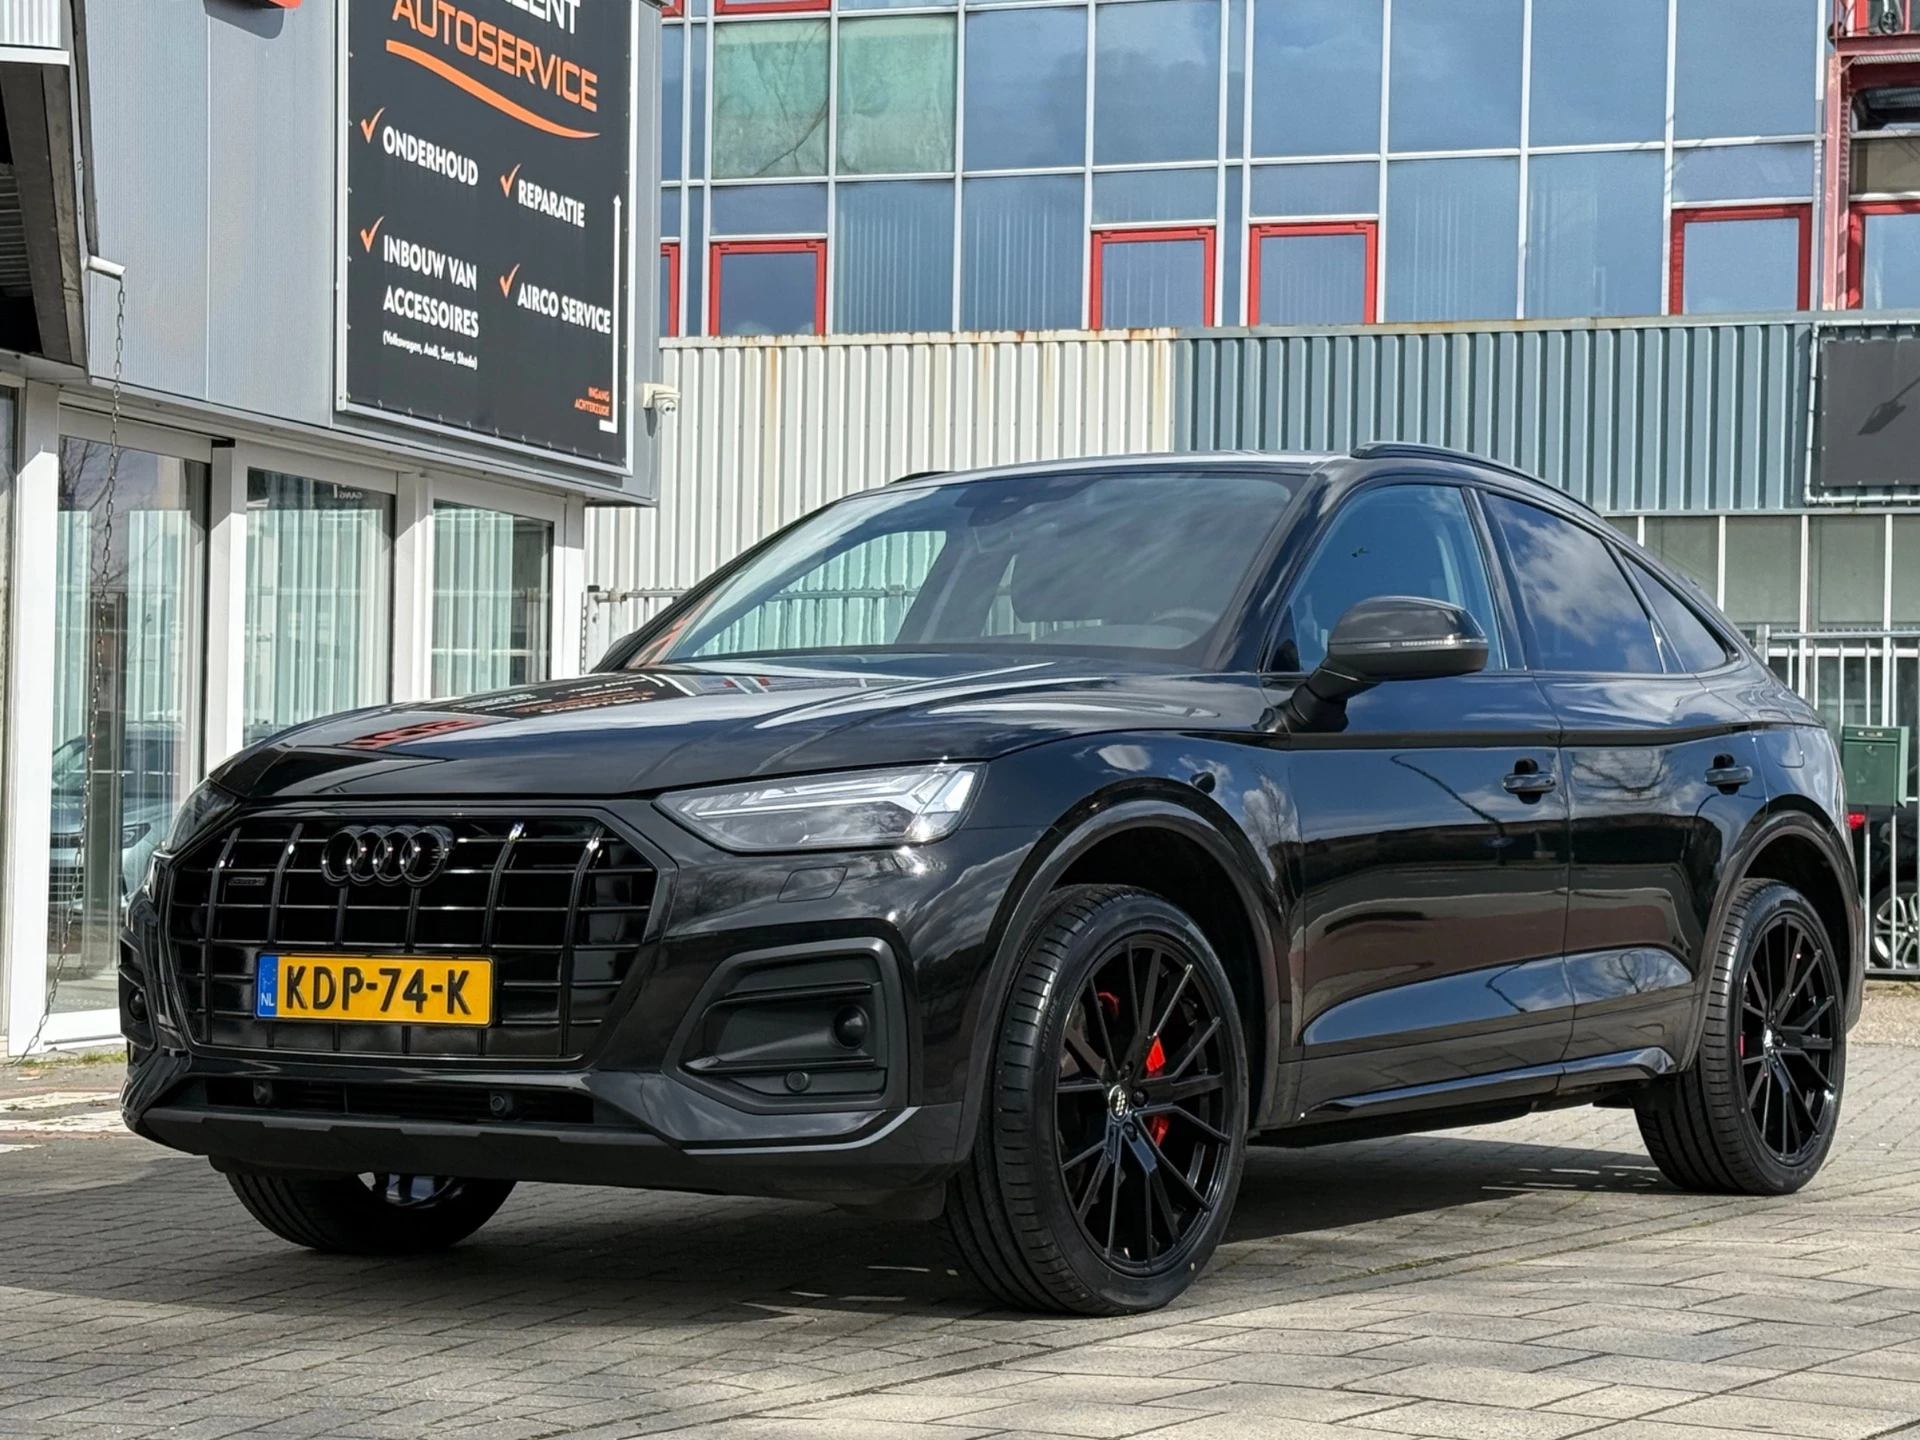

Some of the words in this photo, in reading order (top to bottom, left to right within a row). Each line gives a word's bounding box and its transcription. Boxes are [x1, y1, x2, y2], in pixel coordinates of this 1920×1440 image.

[392, 0, 598, 112] AUTOSERVICE
[382, 125, 479, 187] ONDERHOUD
[518, 179, 586, 228] REPARATIE
[384, 235, 445, 279] INBOUW
[448, 256, 477, 291] VAN
[383, 285, 479, 338] ACCESSOIRES
[517, 282, 559, 318] AIRCO
[561, 298, 612, 334] SERVICE
[261, 993, 275, 1007] NL
[286, 965, 472, 1015] KDP-74-K
